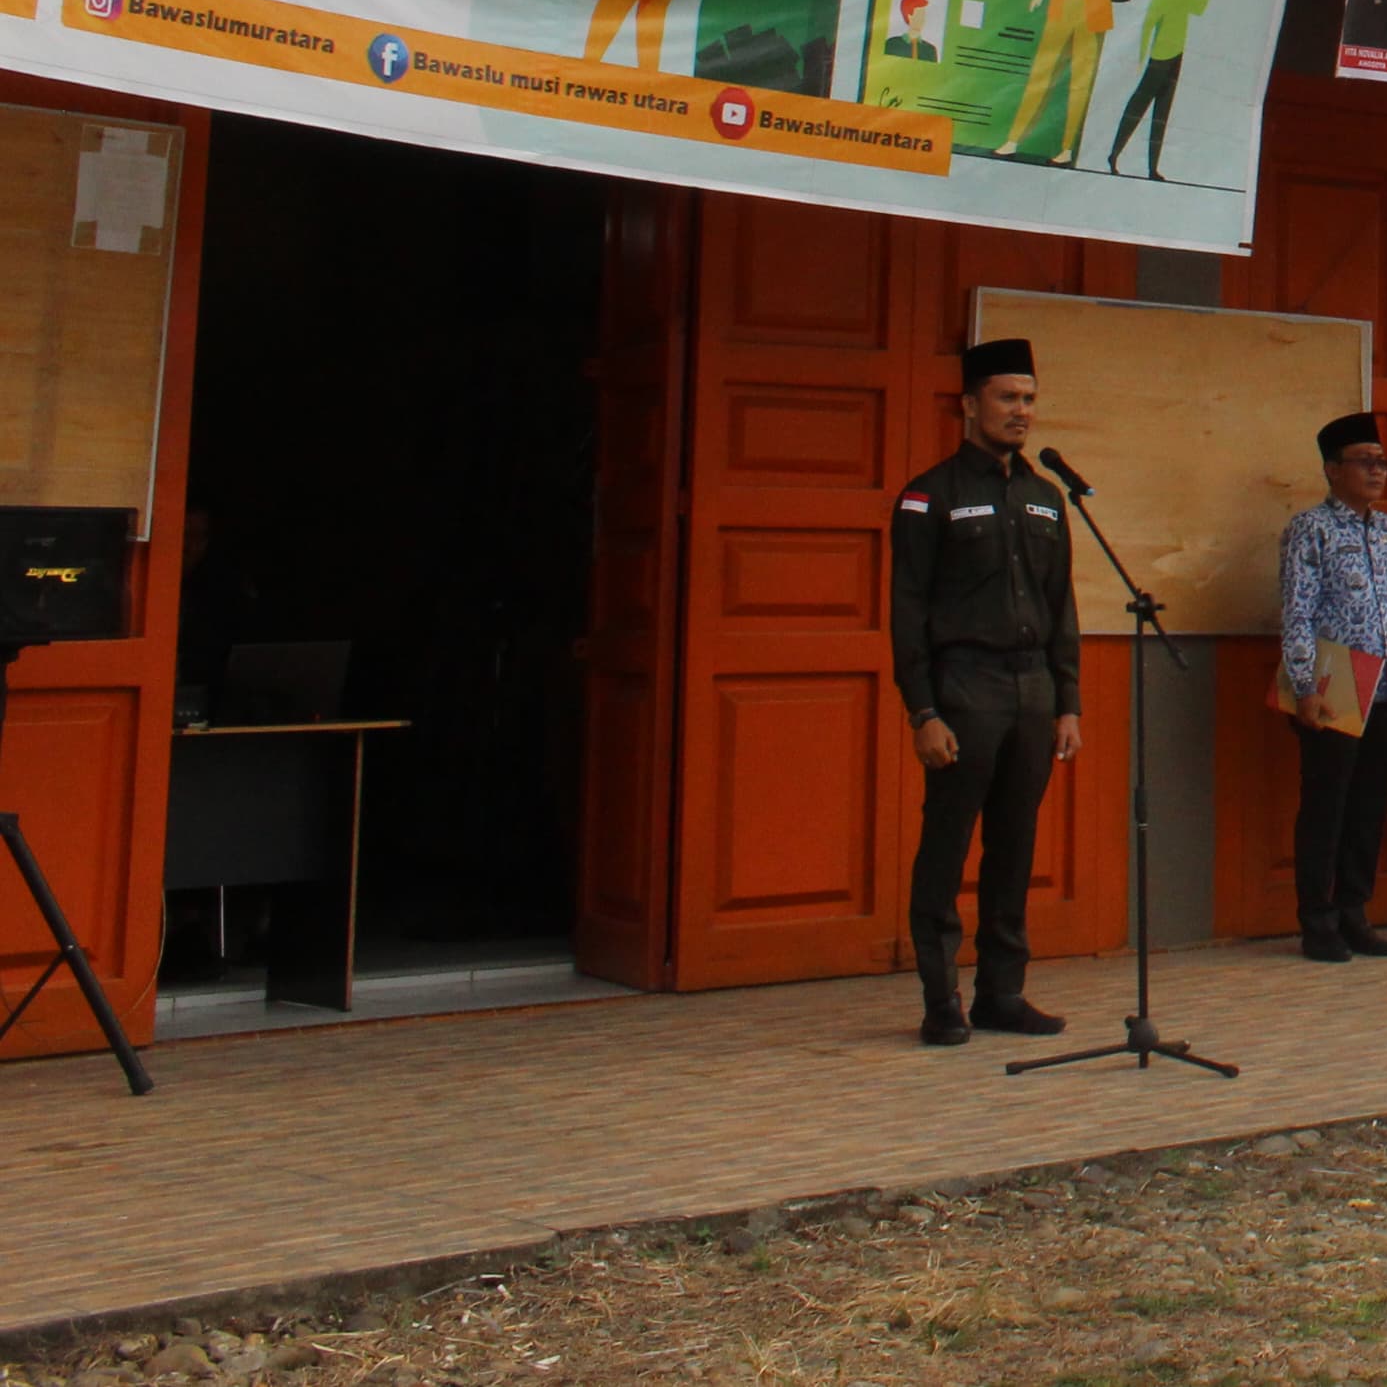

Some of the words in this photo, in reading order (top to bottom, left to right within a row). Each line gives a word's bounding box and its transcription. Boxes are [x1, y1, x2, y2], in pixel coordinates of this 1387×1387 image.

[412, 51, 504, 86] Bawaslu
[510, 69, 561, 96] musi
[565, 77, 628, 106] rawas
[633, 88, 689, 116] utara
[758, 110, 934, 154] Bawaslumuratara
